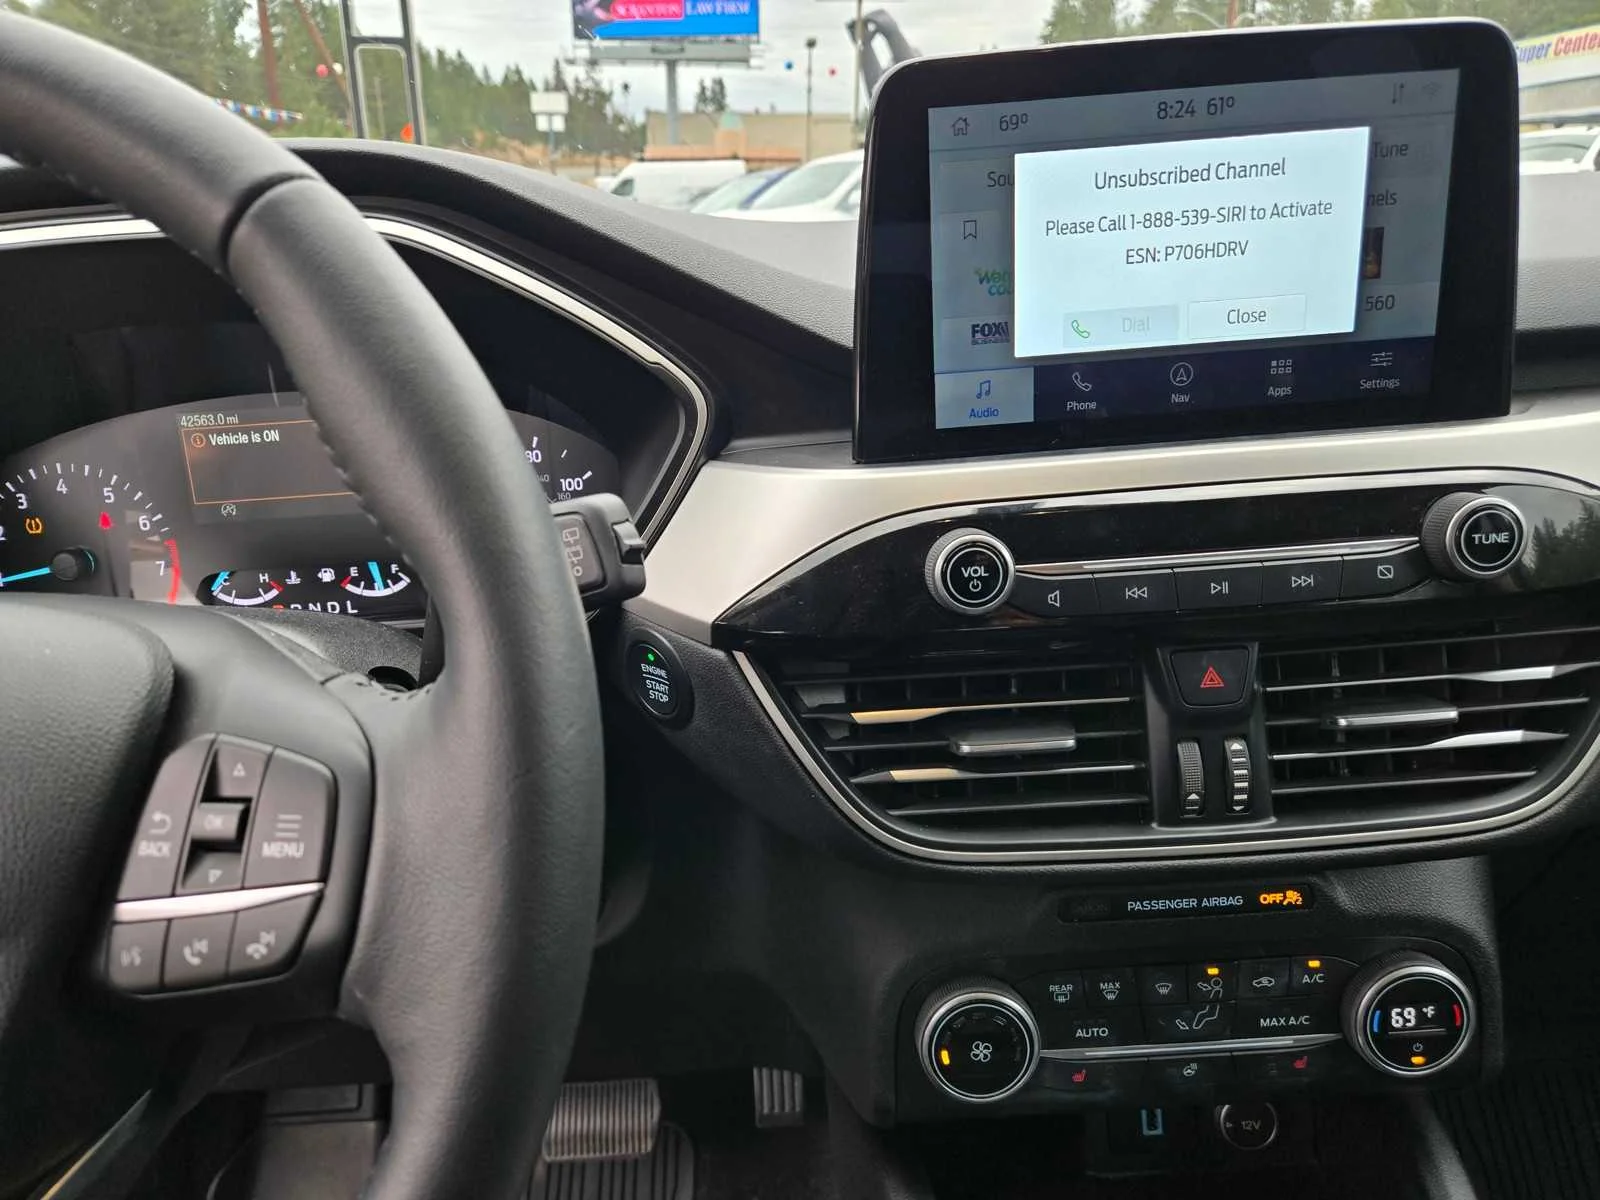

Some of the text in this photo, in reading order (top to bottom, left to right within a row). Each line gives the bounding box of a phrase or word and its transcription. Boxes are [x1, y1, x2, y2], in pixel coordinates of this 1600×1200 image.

[1157, 100, 1195, 119] 8:24
[1373, 142, 1409, 158] Tune
[1094, 157, 1286, 190] Unsubscribed Channel
[1045, 199, 1333, 236] Please Call 1-888-539-SIRI to Activate
[1126, 240, 1249, 265] ESN: P706HDRV
[1364, 294, 1395, 312] 560
[1121, 315, 1150, 333] Dial
[1226, 308, 1267, 325] Close
[1267, 386, 1292, 397] Apps
[1359, 378, 1400, 391] Settings
[1066, 400, 1097, 411] Phone
[1171, 393, 1190, 403] Nav
[968, 406, 999, 419] Audio
[180, 413, 239, 428] 42563.0 mi
[208, 430, 280, 446] Vehicle is ON
[56, 478, 69, 495] 4
[559, 478, 584, 492] 100
[15, 493, 28, 510] 3
[103, 487, 115, 503] 5
[138, 515, 151, 531] 6
[1471, 532, 1510, 545] TUNE
[155, 560, 166, 576] 7
[350, 566, 359, 577] E
[391, 564, 400, 574] F
[961, 566, 989, 578] VOL
[259, 573, 269, 583] H
[327, 601, 341, 614] D
[348, 600, 359, 614] L
[641, 663, 668, 679] ENGINE
[645, 679, 669, 694] START
[649, 689, 669, 703] STOP
[203, 814, 224, 830] OK
[137, 840, 171, 857] BACK
[261, 841, 305, 858] MENU
[1127, 892, 1284, 912] PASSENGER AIRBAG OFF
[1100, 982, 1121, 990] MAX
[1302, 973, 1325, 984] A/C
[1050, 984, 1073, 993] REAR
[1260, 1015, 1310, 1028] MAX A/C
[1390, 1007, 1416, 1029] 69
[1075, 1027, 1109, 1039] AUTO
[1240, 1120, 1261, 1131] 12V
